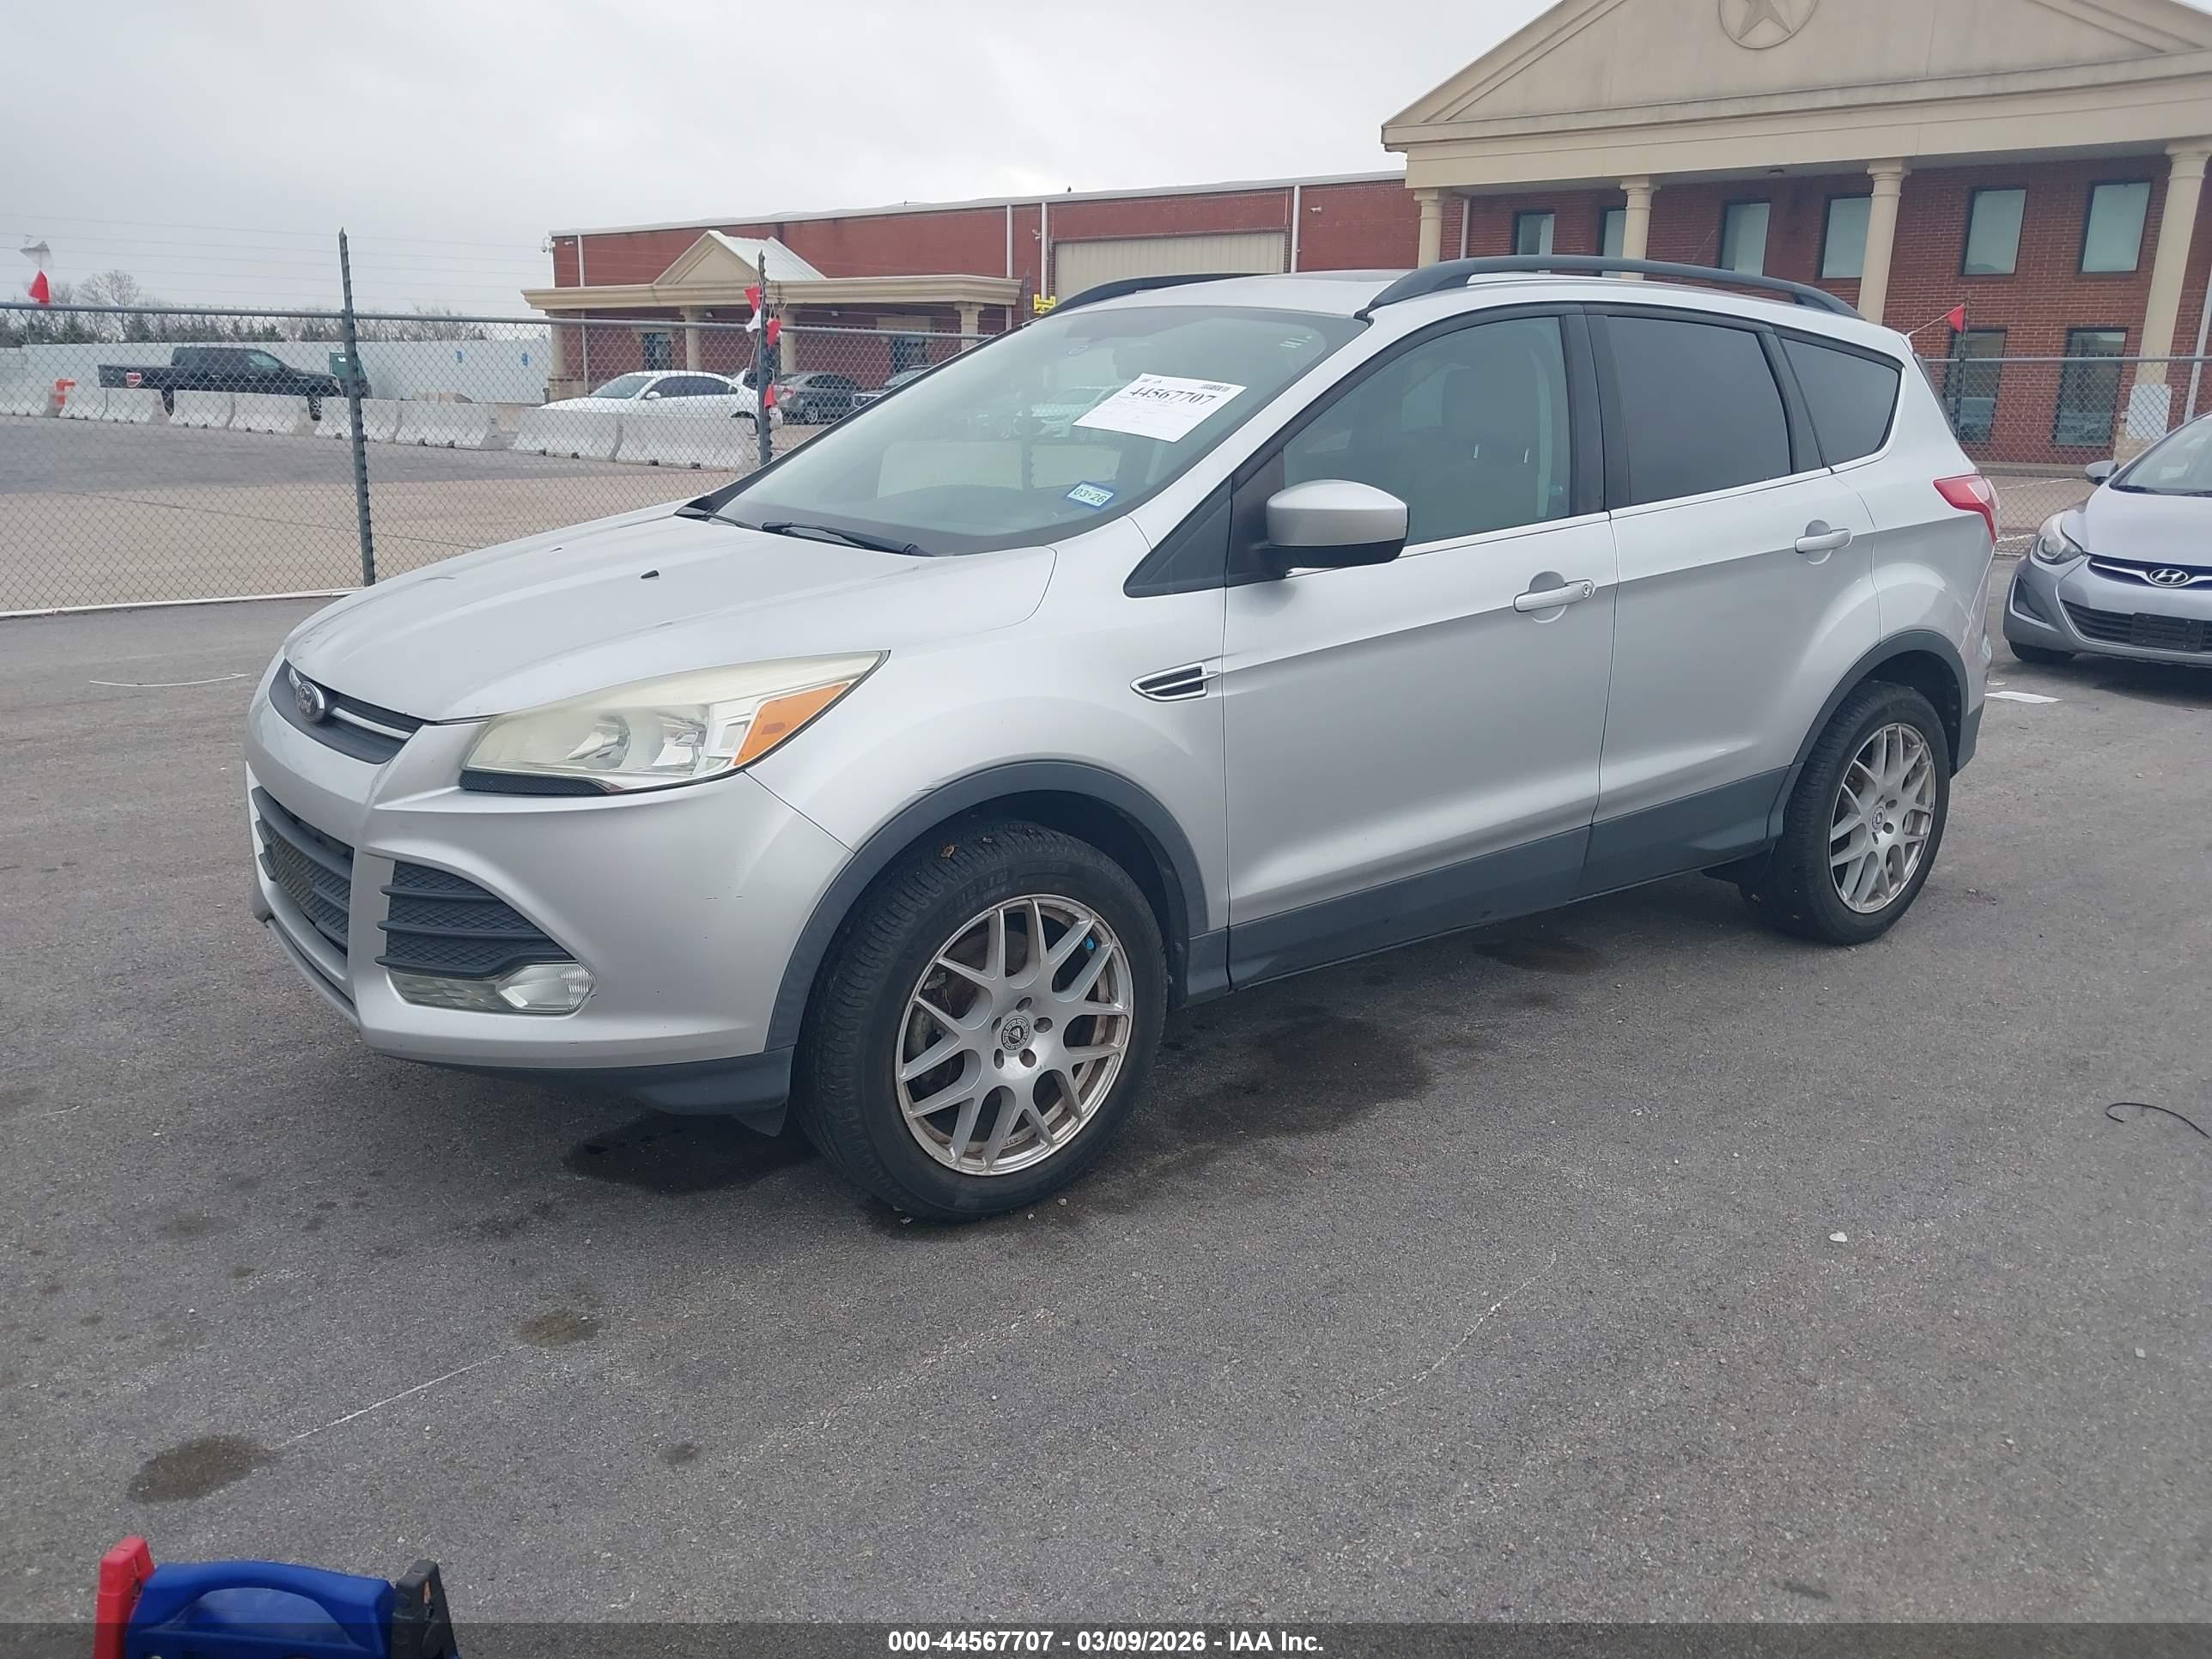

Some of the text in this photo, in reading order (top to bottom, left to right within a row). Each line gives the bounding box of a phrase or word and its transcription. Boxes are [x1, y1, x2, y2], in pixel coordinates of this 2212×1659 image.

[1129, 386, 1217, 405] 44567707
[1073, 488, 1107, 503] 03 26
